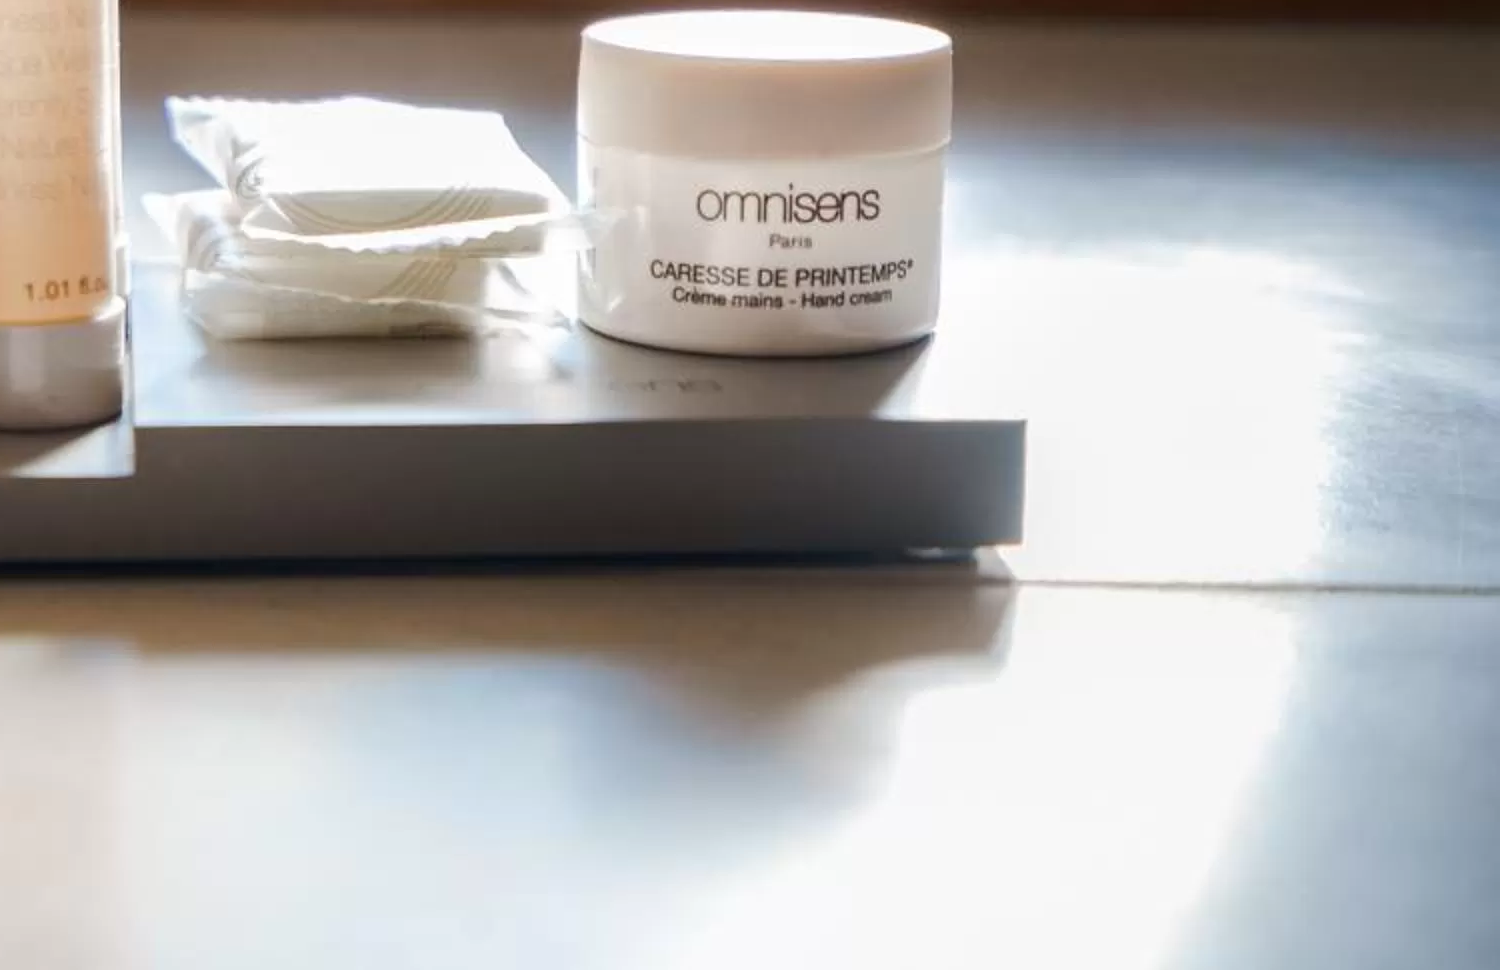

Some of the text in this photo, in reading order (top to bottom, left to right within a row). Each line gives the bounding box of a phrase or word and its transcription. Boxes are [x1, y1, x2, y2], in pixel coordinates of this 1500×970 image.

[696, 182, 880, 224] omnisens
[769, 233, 814, 250] Paris
[649, 258, 751, 287] CARESSE
[757, 267, 790, 288] DE
[23, 279, 71, 303] 1.01
[672, 285, 728, 308] Crème
[731, 291, 785, 310] mains
[800, 289, 846, 310] Hand
[848, 289, 893, 307] cream
